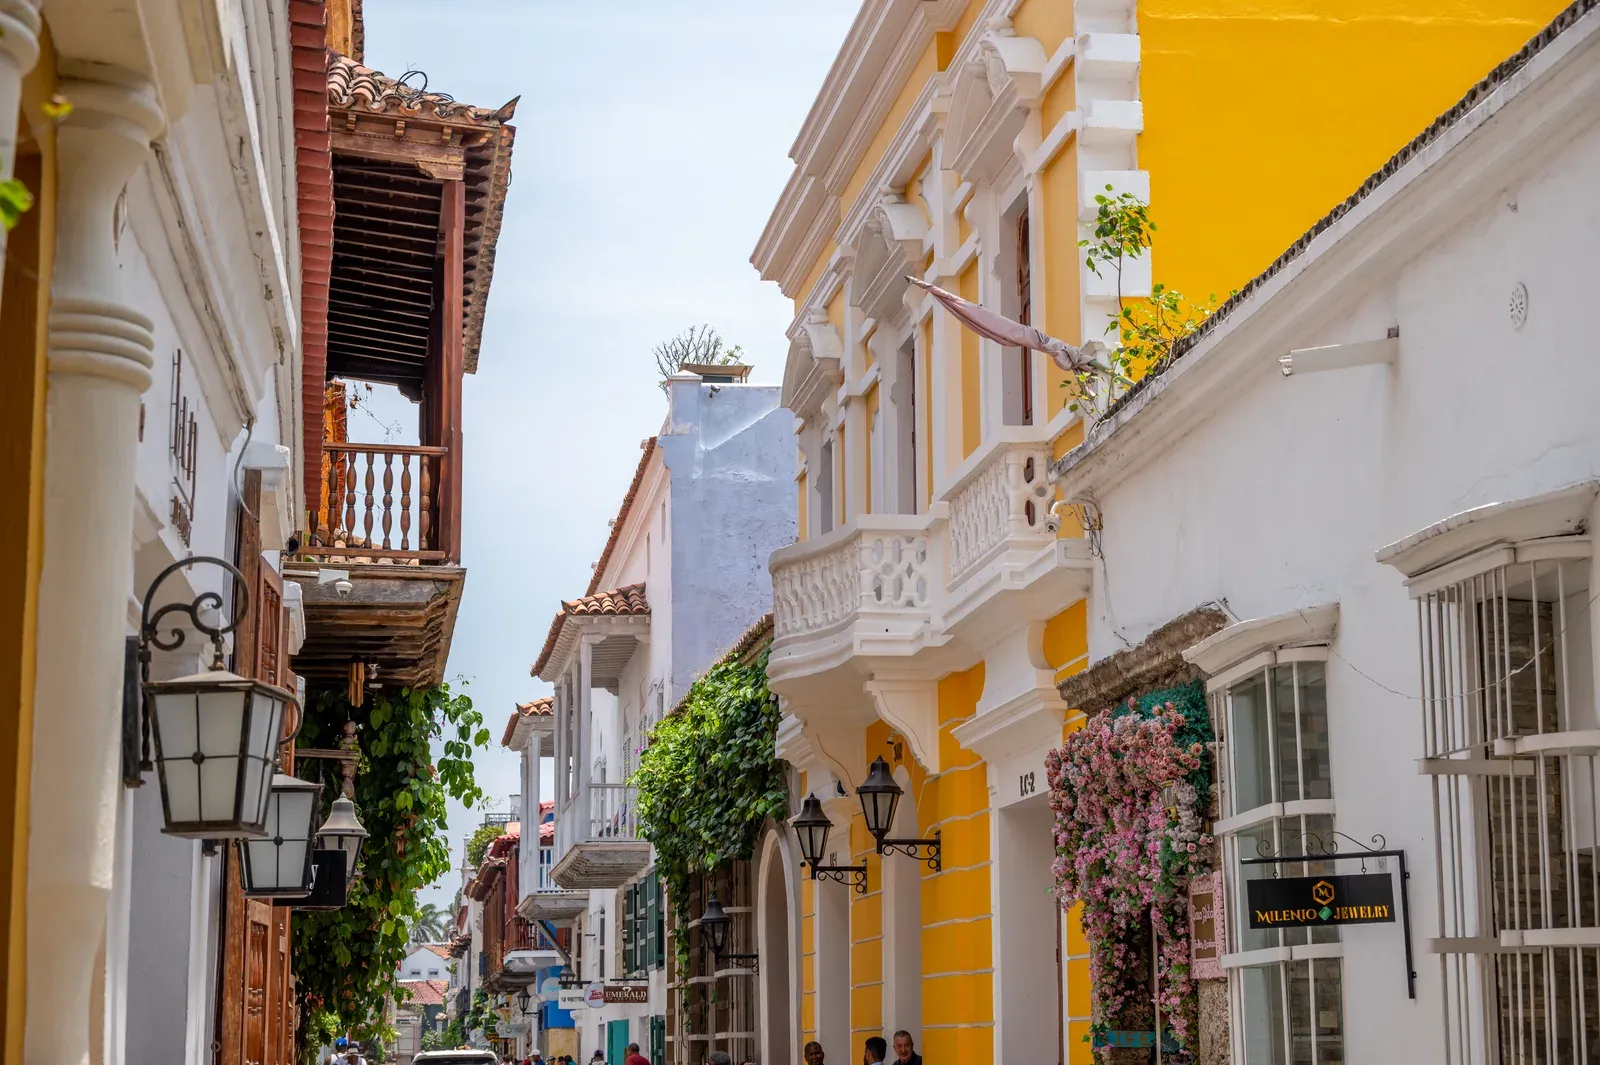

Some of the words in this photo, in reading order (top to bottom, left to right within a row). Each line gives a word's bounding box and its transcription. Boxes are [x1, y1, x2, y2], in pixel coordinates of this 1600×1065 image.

[1317, 887, 1330, 898] M
[1255, 909, 1318, 924] MILENIO
[1333, 905, 1389, 920] JEWELRY
[605, 990, 647, 999] EMERALD
